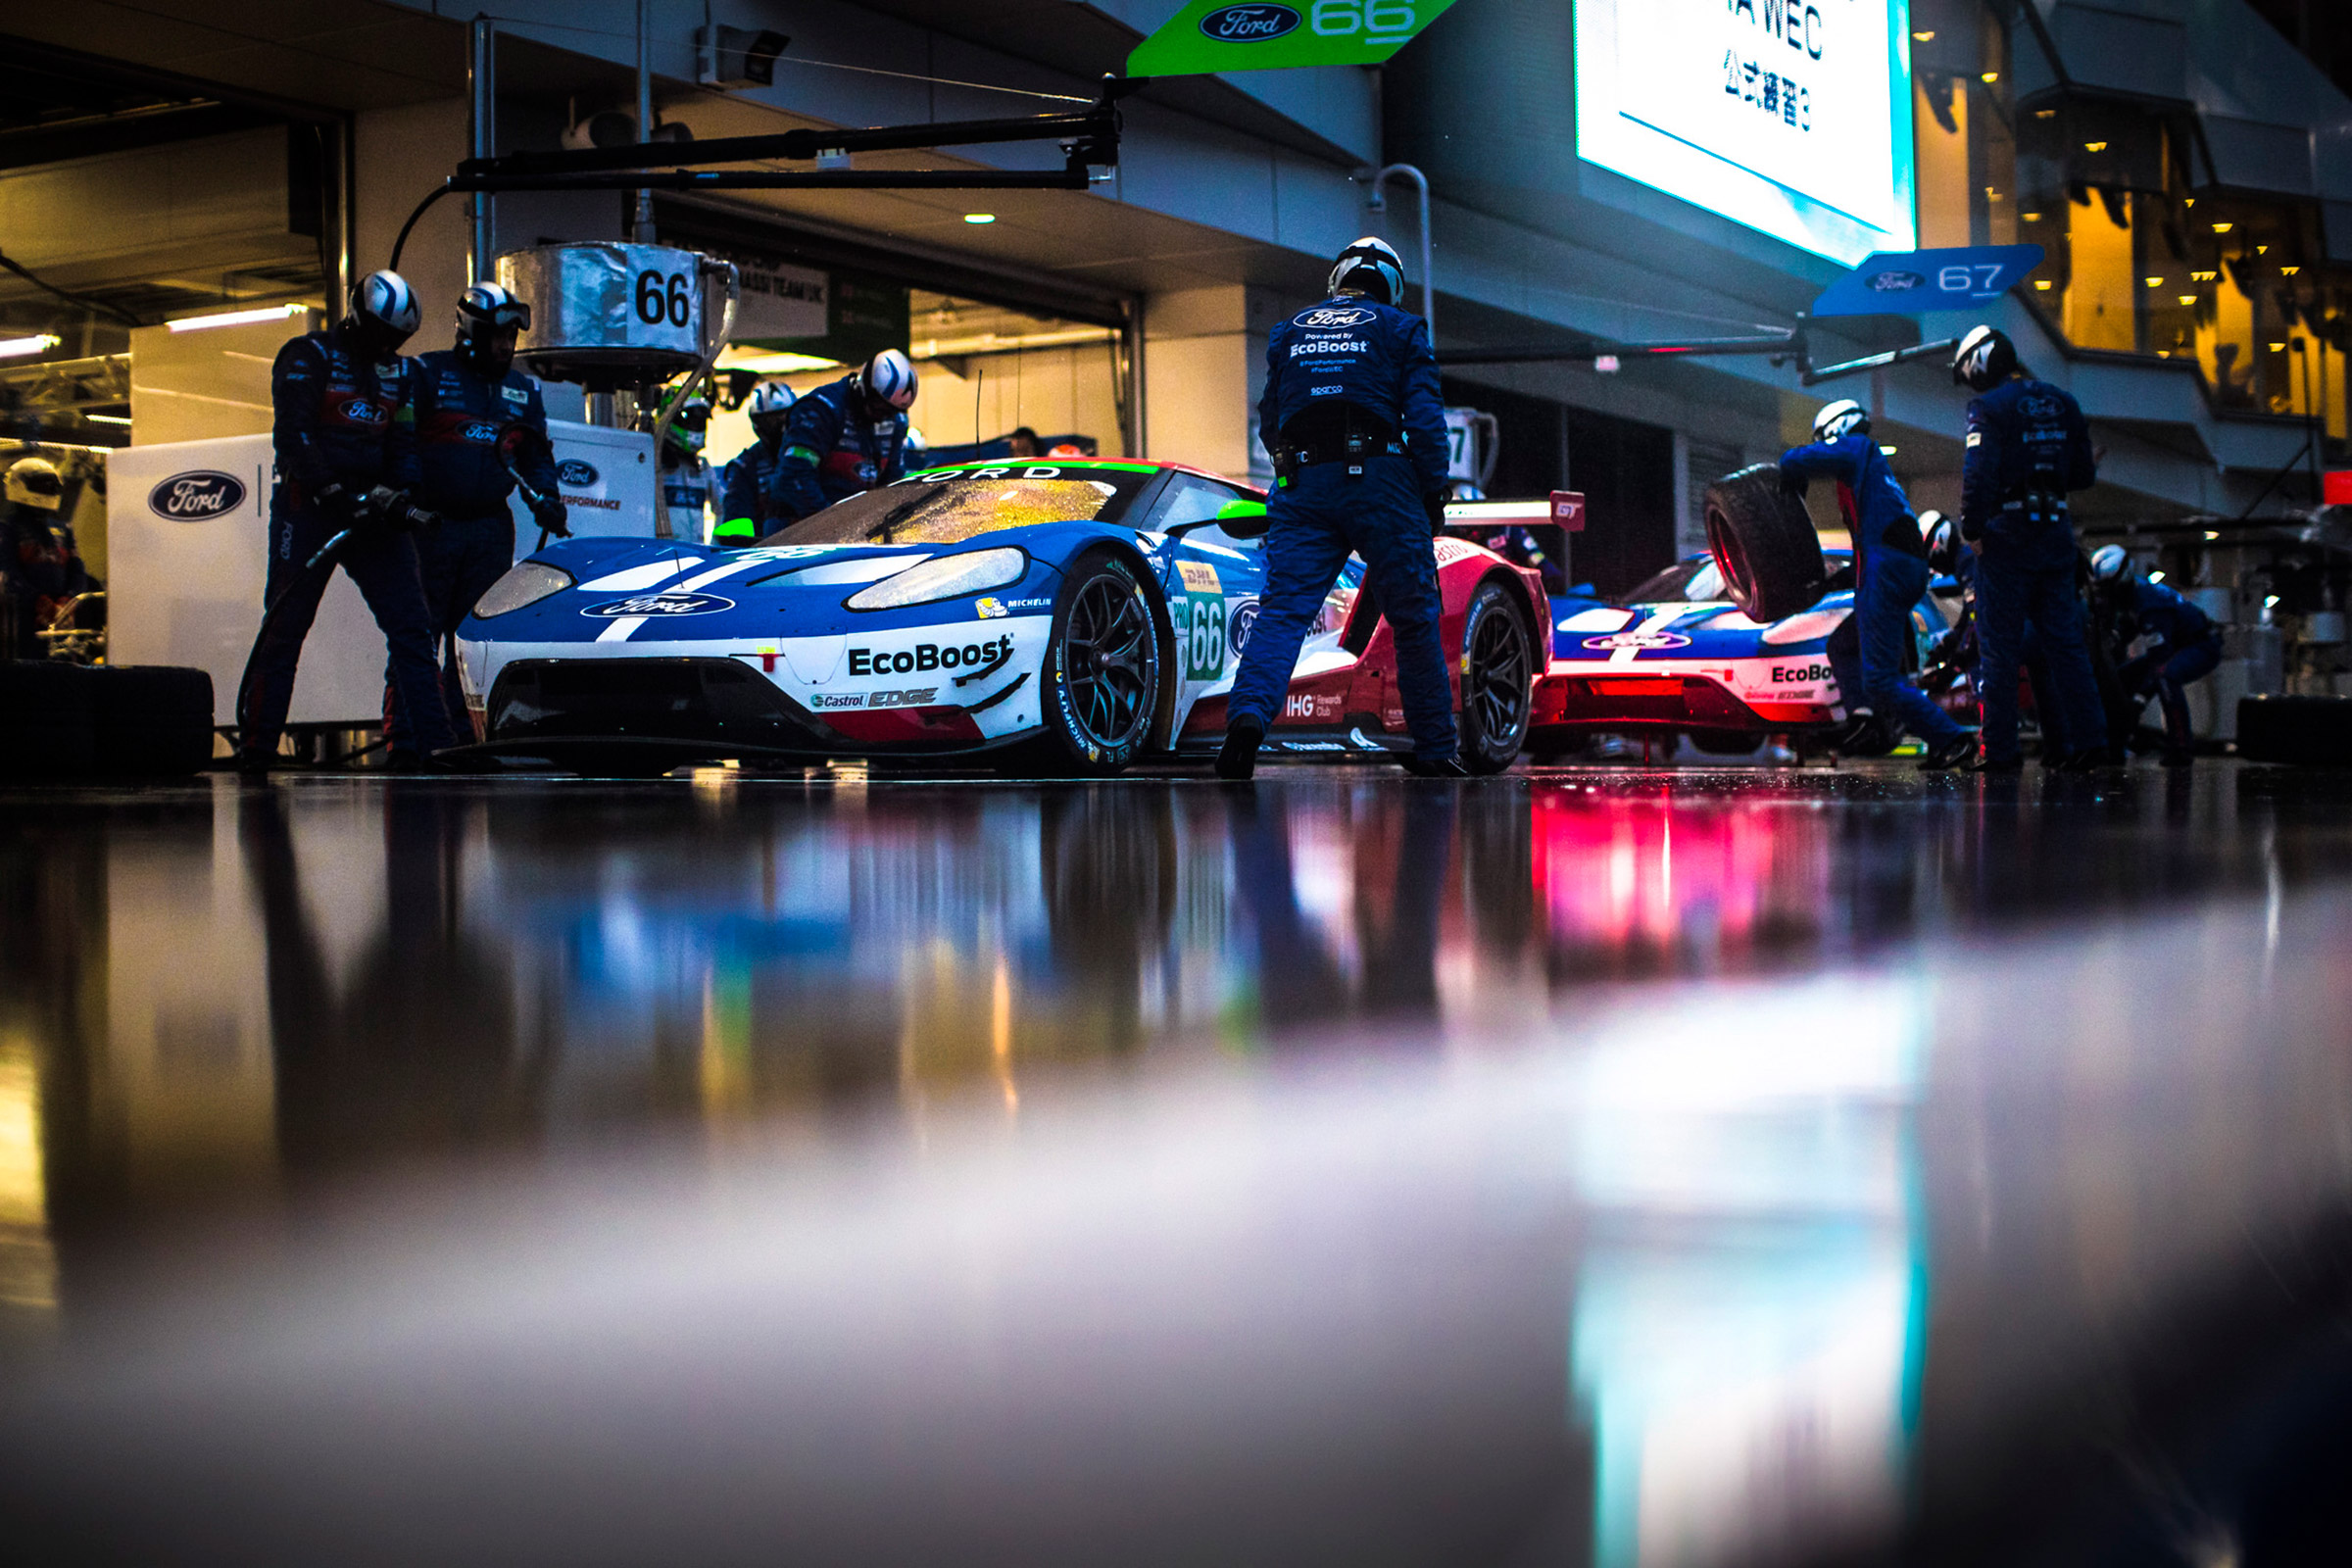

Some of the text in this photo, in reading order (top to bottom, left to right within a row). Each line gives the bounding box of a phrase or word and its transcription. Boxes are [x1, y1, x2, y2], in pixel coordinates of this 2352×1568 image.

[1219, 0, 1415, 36] Ford 66
[1875, 264, 2004, 292] Ford 67
[636, 270, 690, 327] 66
[1306, 311, 1361, 325] Ford
[1290, 340, 1368, 358] EcoBoost
[1310, 384, 1344, 396] sparco
[887, 466, 1061, 487] FORD
[168, 479, 226, 514] Ford
[560, 494, 620, 511] ERFORMANCE
[280, 521, 294, 560] FORD
[603, 594, 709, 614] Ford
[1007, 598, 1052, 609] MICHELIN
[1173, 601, 1189, 631] PRO
[1192, 600, 1222, 671] 66
[848, 634, 1010, 676] EcoBoost
[1772, 663, 1832, 683] EcoBo
[824, 688, 939, 708] Castrol EDGE
[1287, 694, 1313, 717] IHG
[1316, 695, 1342, 706] Rewards
[1316, 707, 1331, 717] Club
